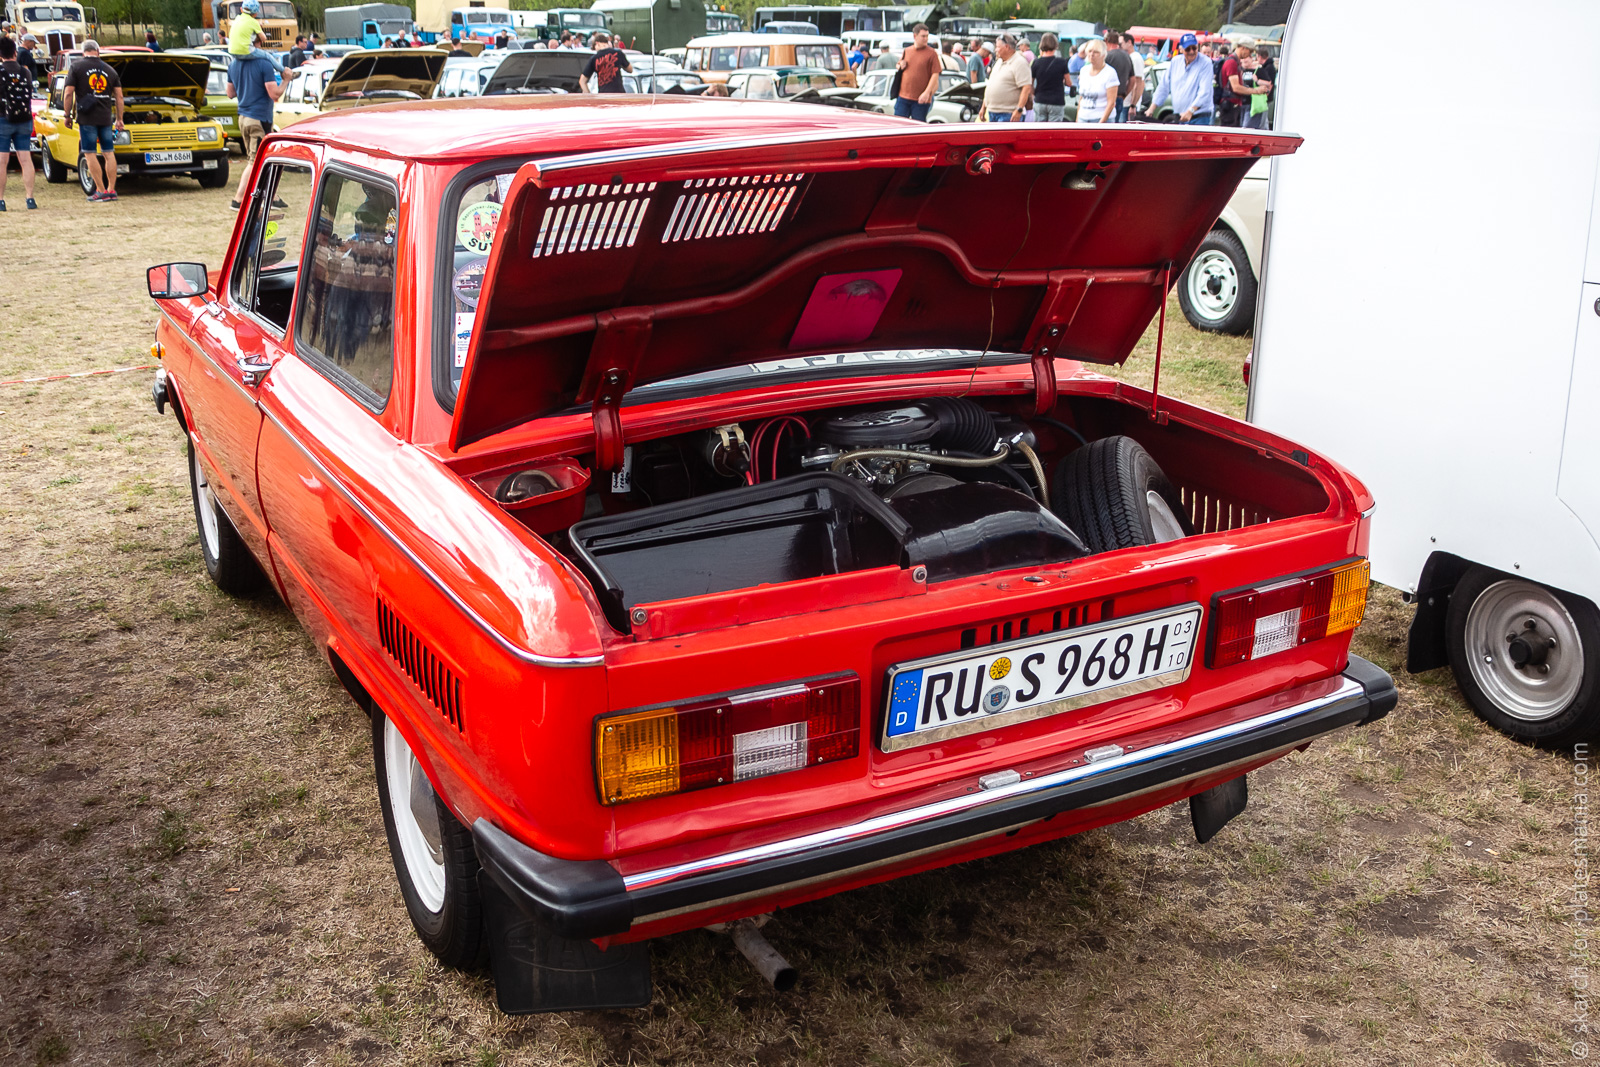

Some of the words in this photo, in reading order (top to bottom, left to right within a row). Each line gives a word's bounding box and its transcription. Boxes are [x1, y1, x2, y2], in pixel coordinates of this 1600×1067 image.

[150, 153, 164, 162] RSL
[468, 237, 492, 251] SU
[1173, 620, 1193, 636] 03
[1168, 651, 1185, 667] 10
[921, 665, 986, 725] RU
[1015, 652, 1046, 703] S
[896, 711, 908, 727] D
